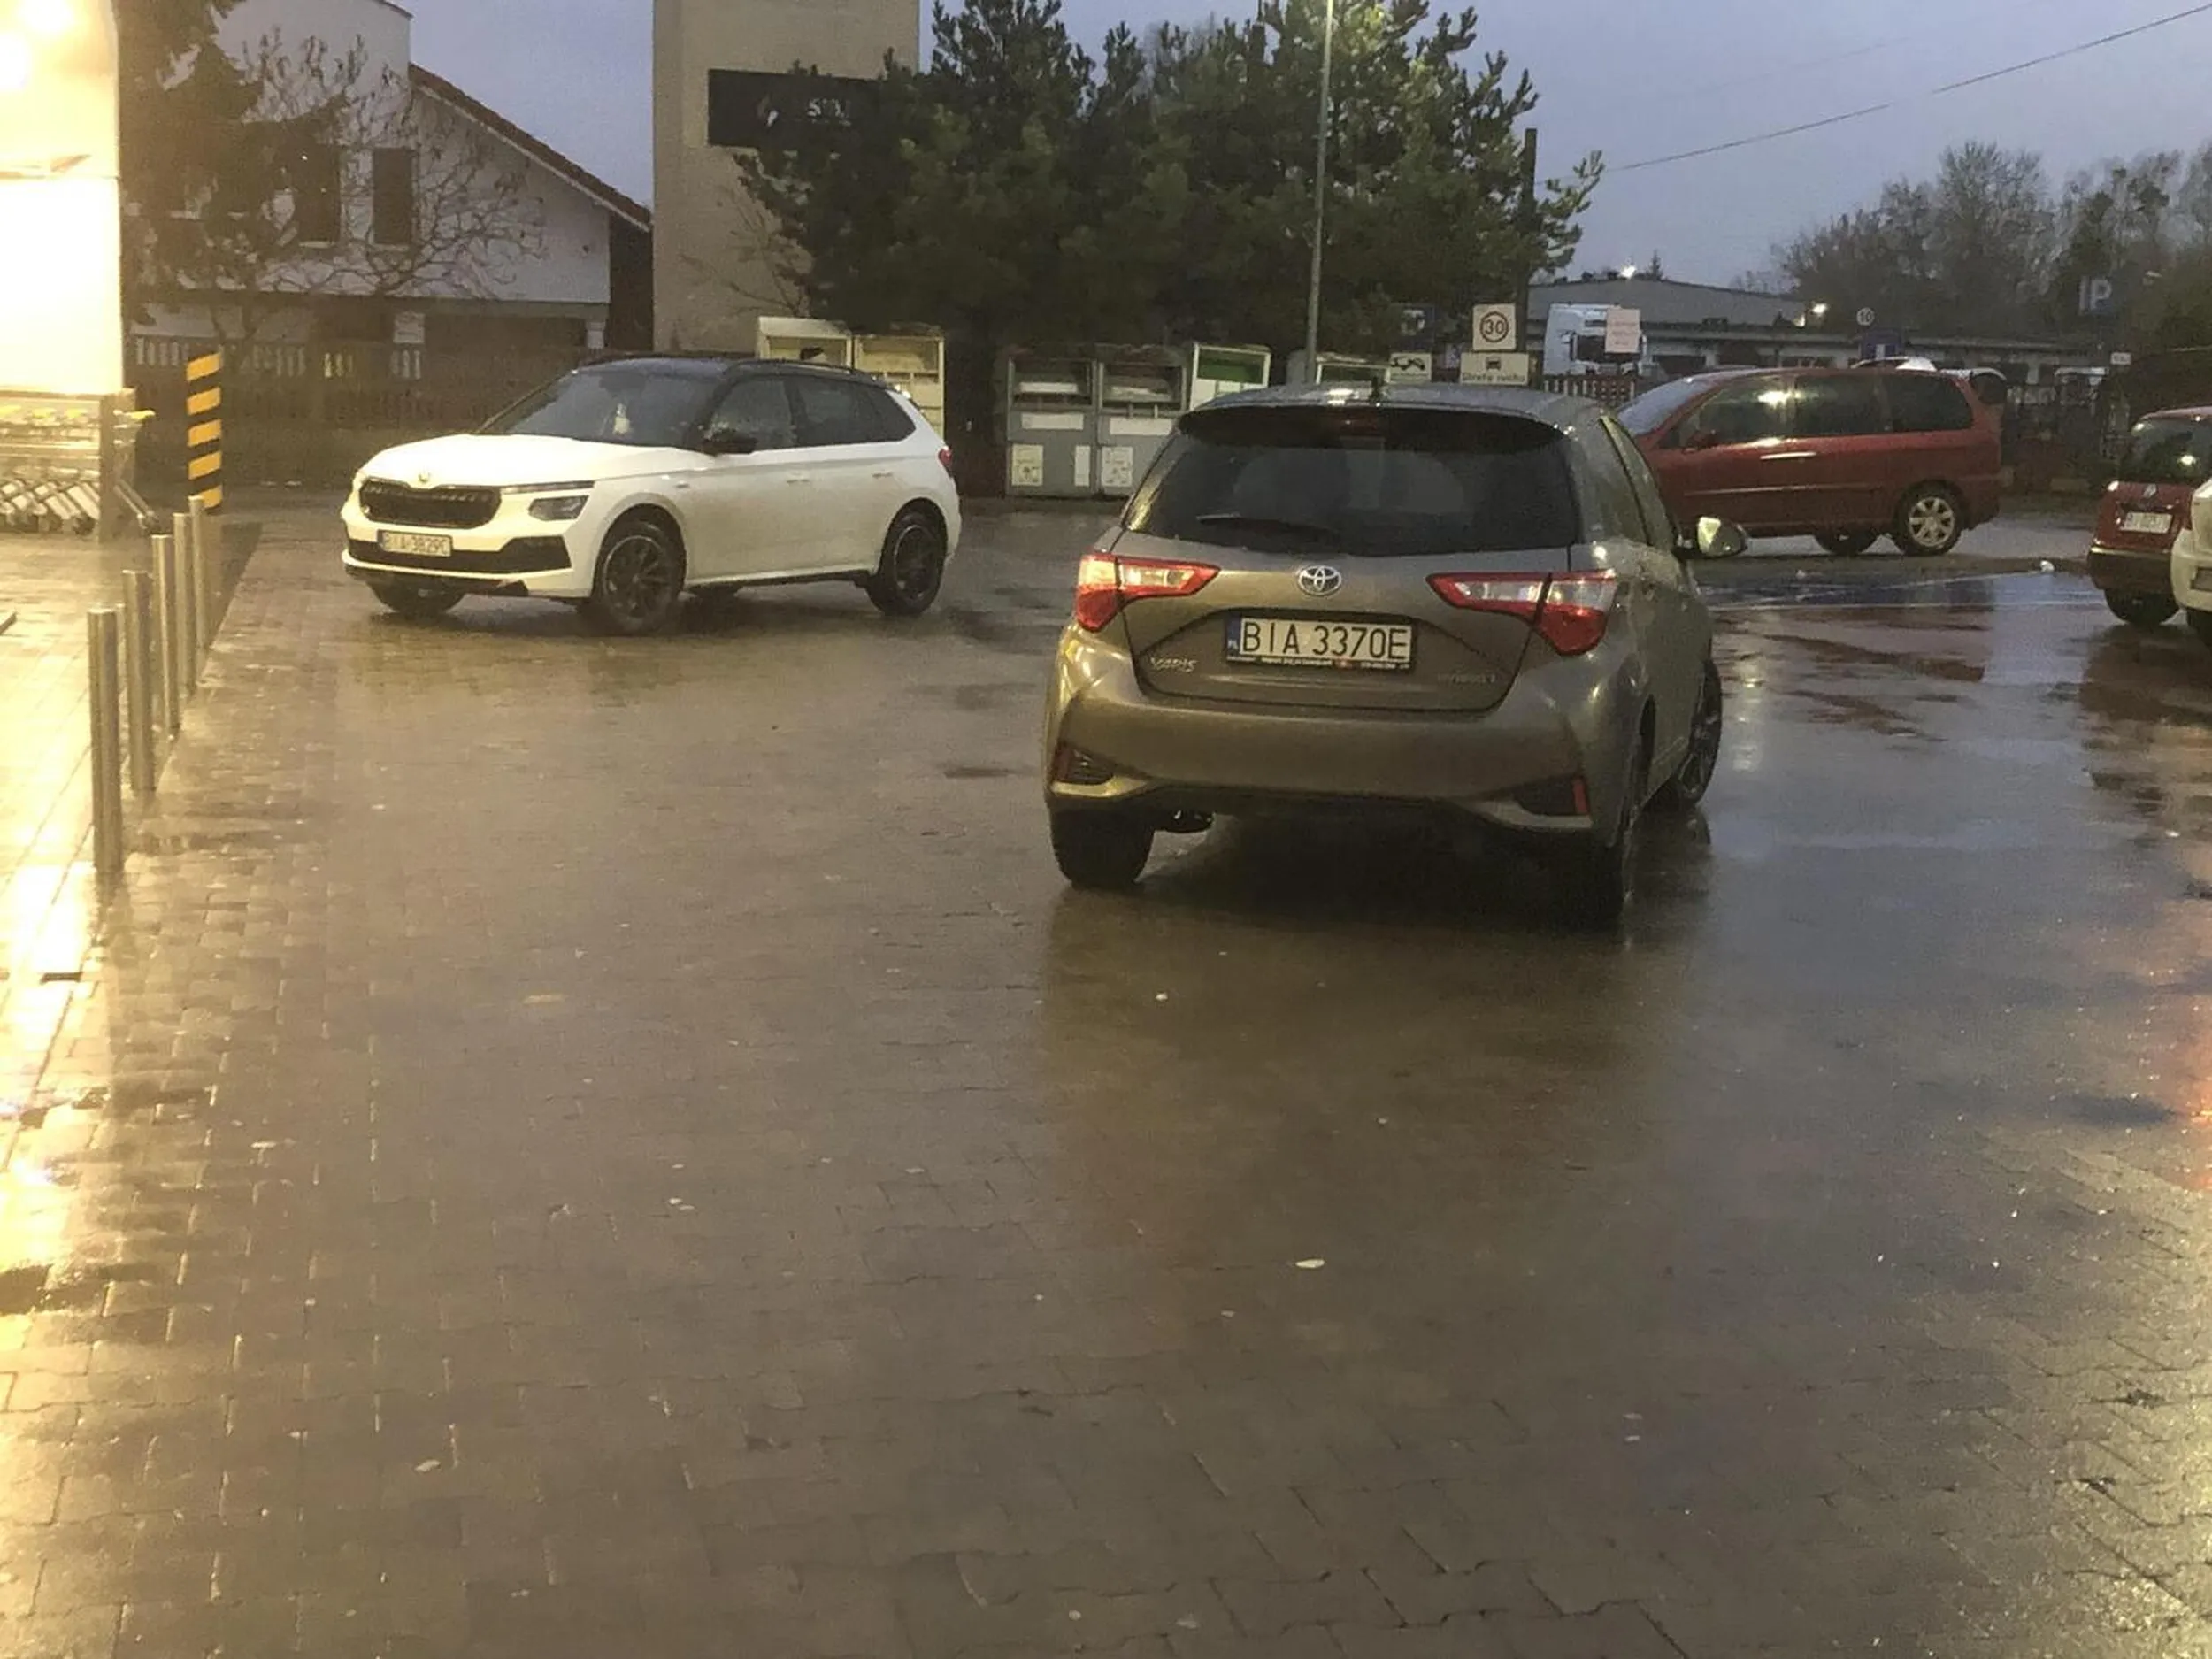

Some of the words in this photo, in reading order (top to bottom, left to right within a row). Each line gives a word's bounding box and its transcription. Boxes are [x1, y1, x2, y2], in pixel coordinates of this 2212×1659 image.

[1485, 319, 1504, 334] 30
[1242, 621, 1300, 655] BIA
[1312, 625, 1408, 660] 3370E
